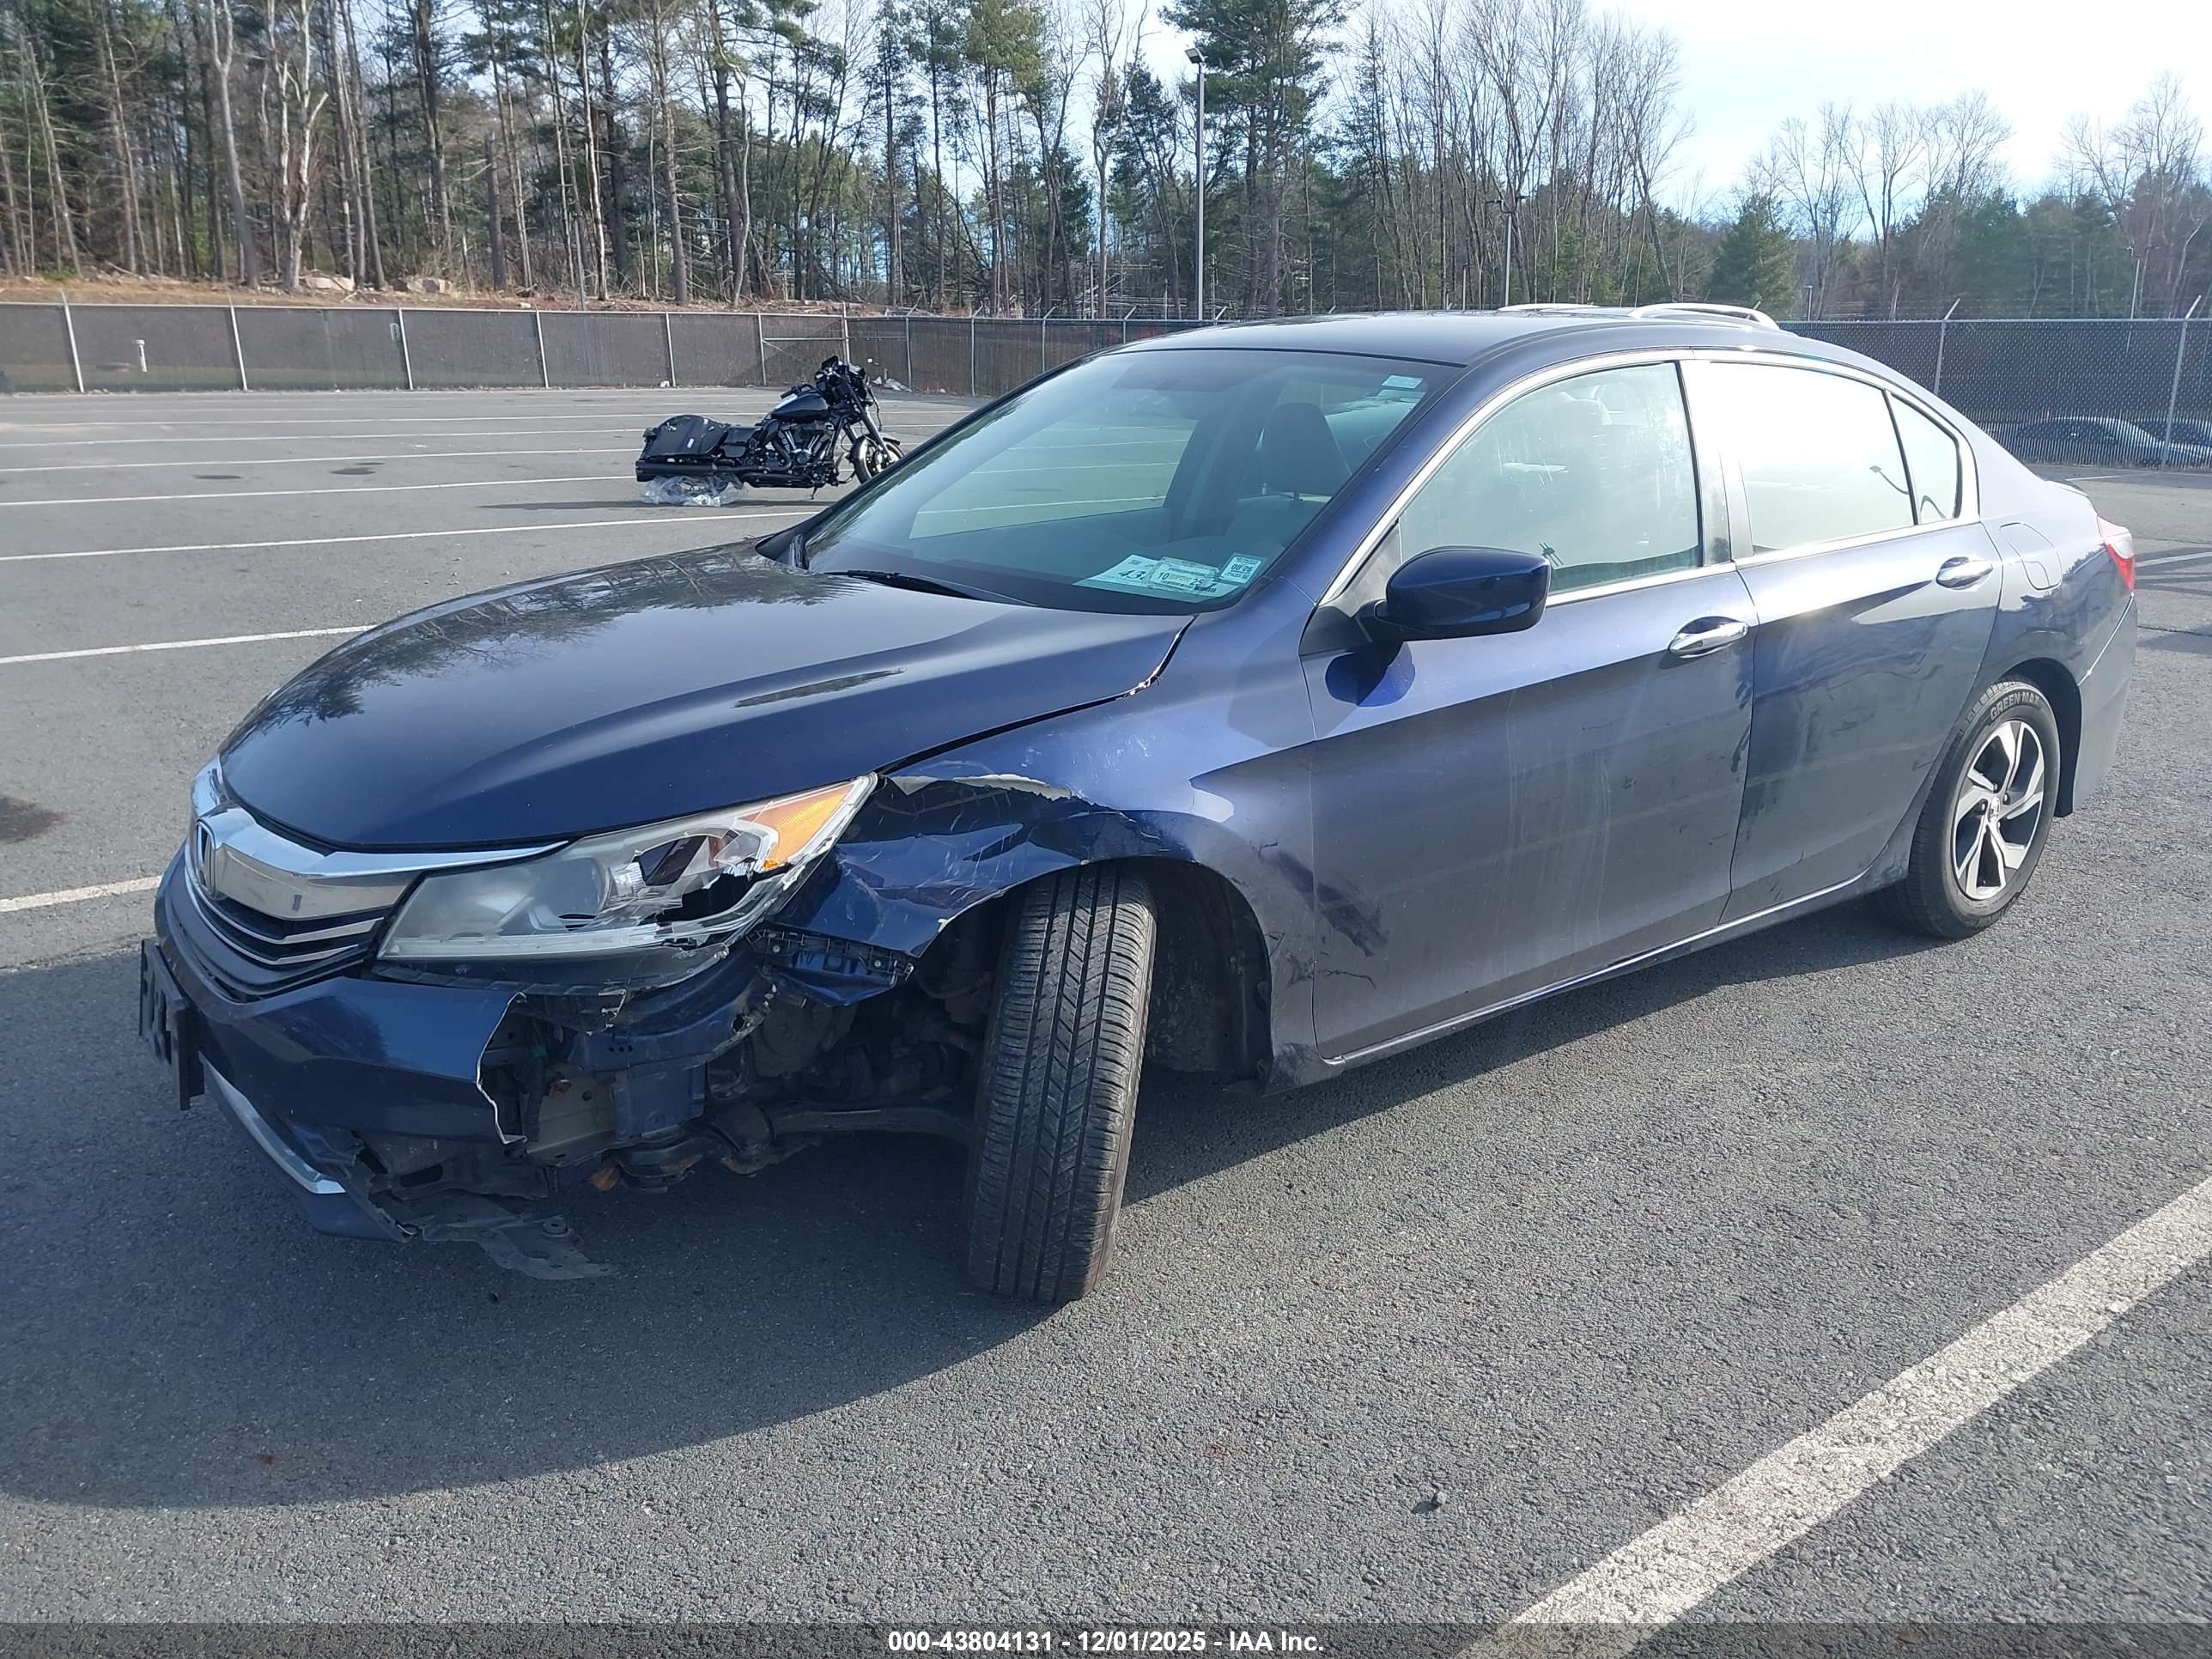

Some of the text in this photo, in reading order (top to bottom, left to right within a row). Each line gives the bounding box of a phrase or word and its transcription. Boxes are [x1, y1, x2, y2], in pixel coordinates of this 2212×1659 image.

[1158, 571, 1170, 580] 10
[1990, 691, 2040, 720] GREEN MAX
